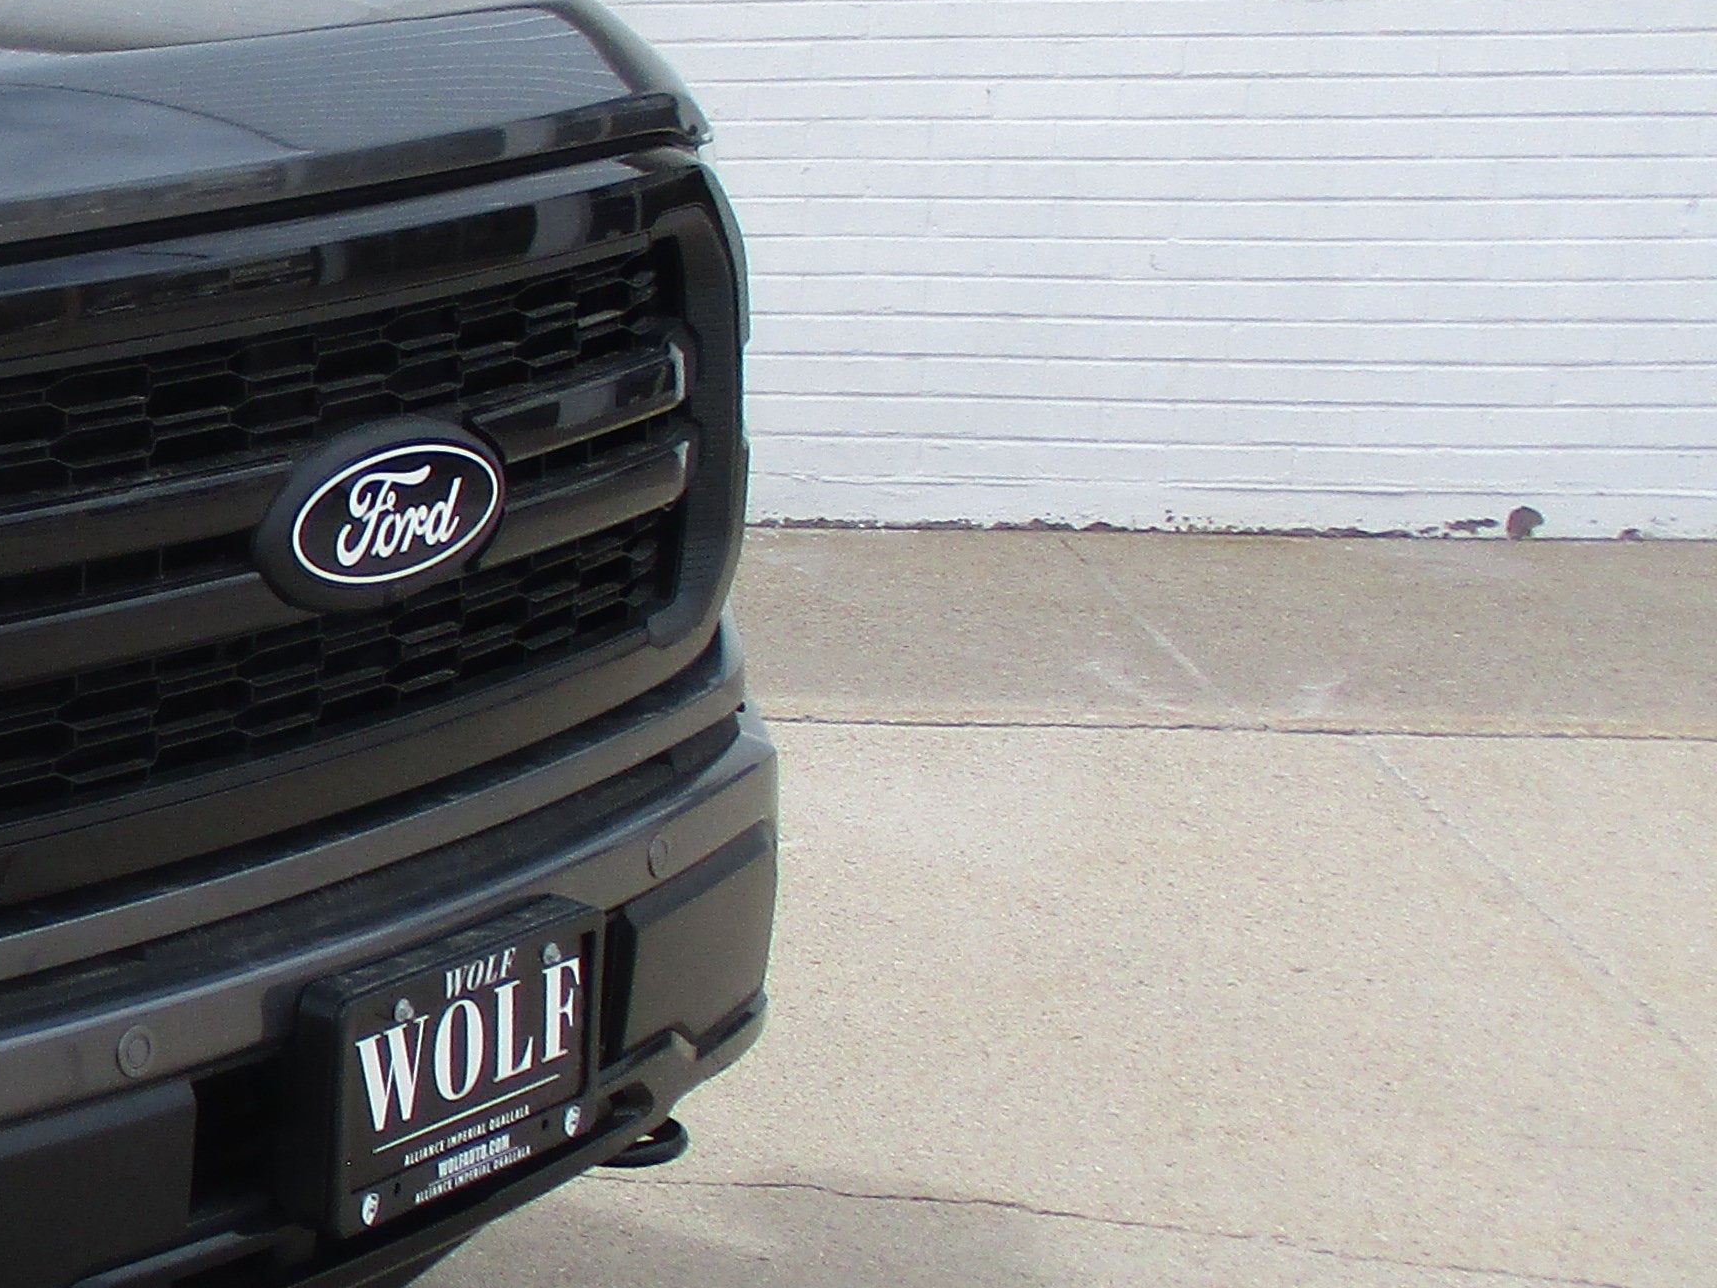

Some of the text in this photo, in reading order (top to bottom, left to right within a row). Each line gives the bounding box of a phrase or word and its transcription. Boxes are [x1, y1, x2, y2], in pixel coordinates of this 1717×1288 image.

[336, 464, 462, 567] Ford
[445, 947, 516, 999] WOLF
[355, 957, 580, 1132] WOLF
